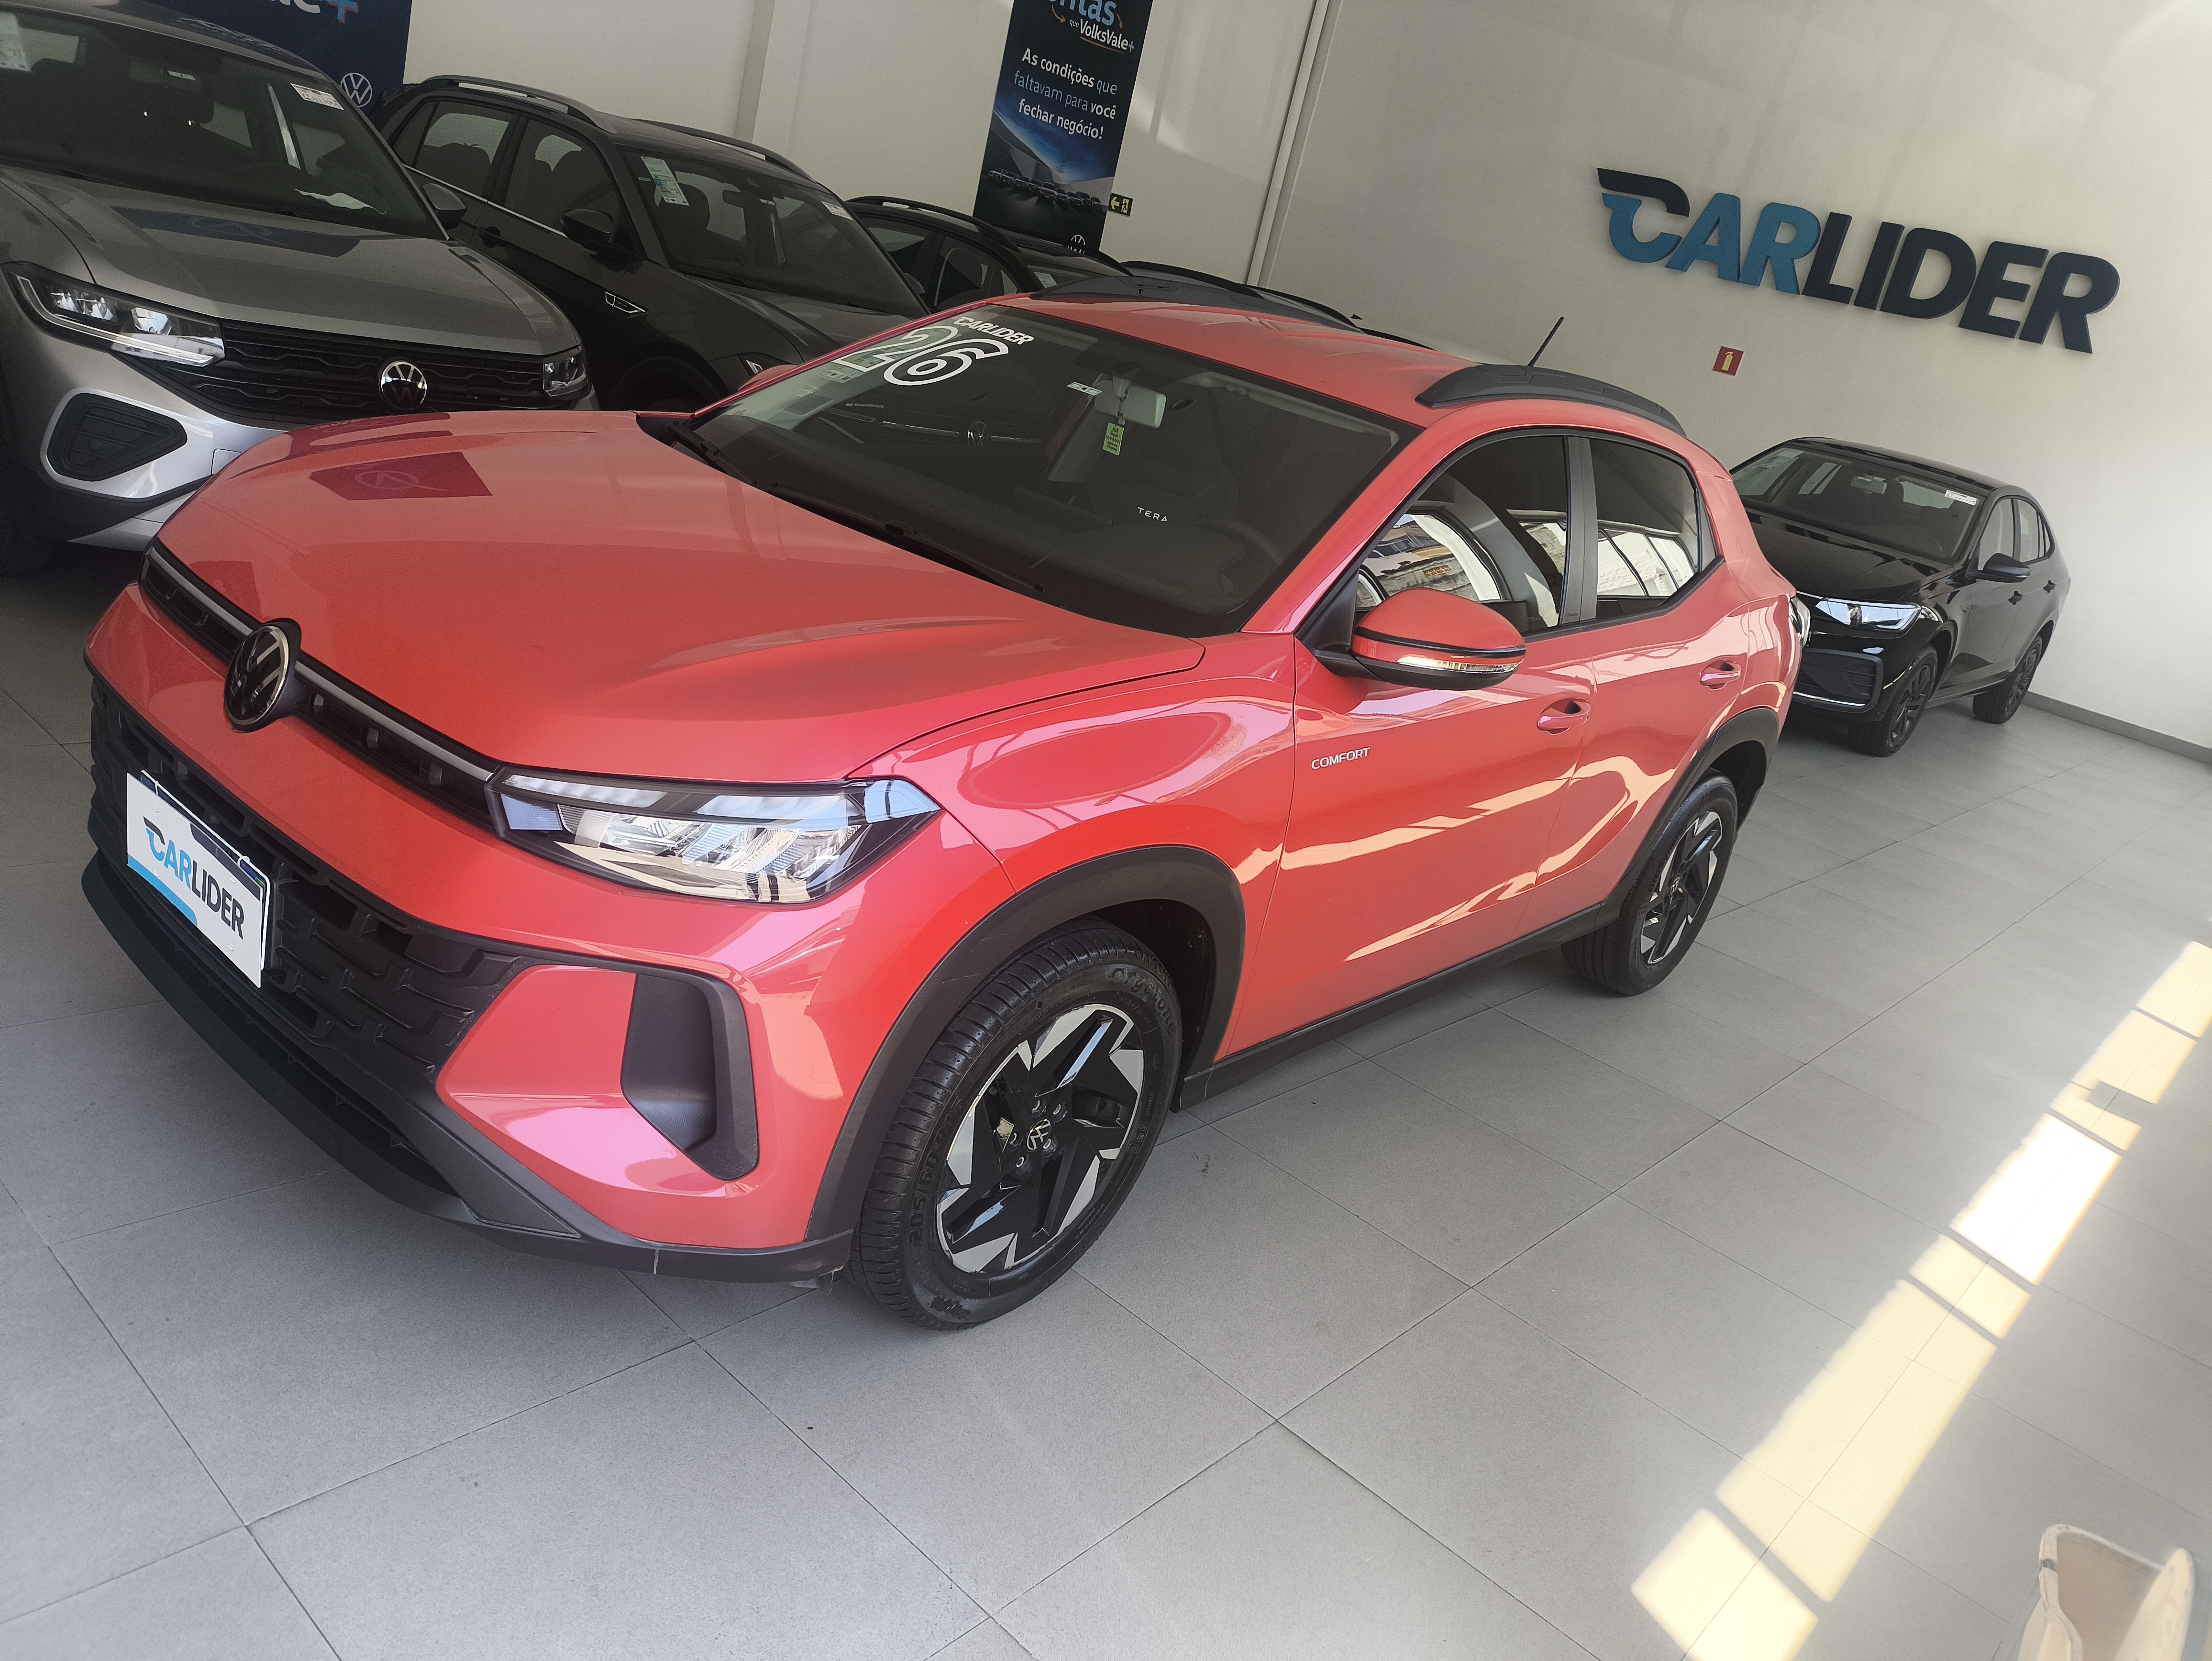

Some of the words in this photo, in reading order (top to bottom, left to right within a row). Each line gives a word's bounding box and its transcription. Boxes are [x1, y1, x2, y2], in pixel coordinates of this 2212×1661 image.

[1069, 20, 1079, 28] que
[1080, 18, 1135, 53] VolksVale+
[1022, 48, 1038, 66] As
[1040, 58, 1095, 88] condições
[1096, 80, 1117, 95] que
[1014, 70, 1062, 102] faltavam
[1064, 94, 1088, 111] para
[1091, 102, 1117, 119] você
[1018, 99, 1055, 124] fechar
[1056, 115, 1104, 140] negócio!
[1597, 167, 2121, 354] CARLIDER
[953, 316, 1035, 345] CARLIDER
[831, 325, 1009, 386] 26
[1138, 507, 1167, 521] TERA
[1311, 747, 1371, 769] COMFORT
[143, 816, 245, 941] CARLIDER
